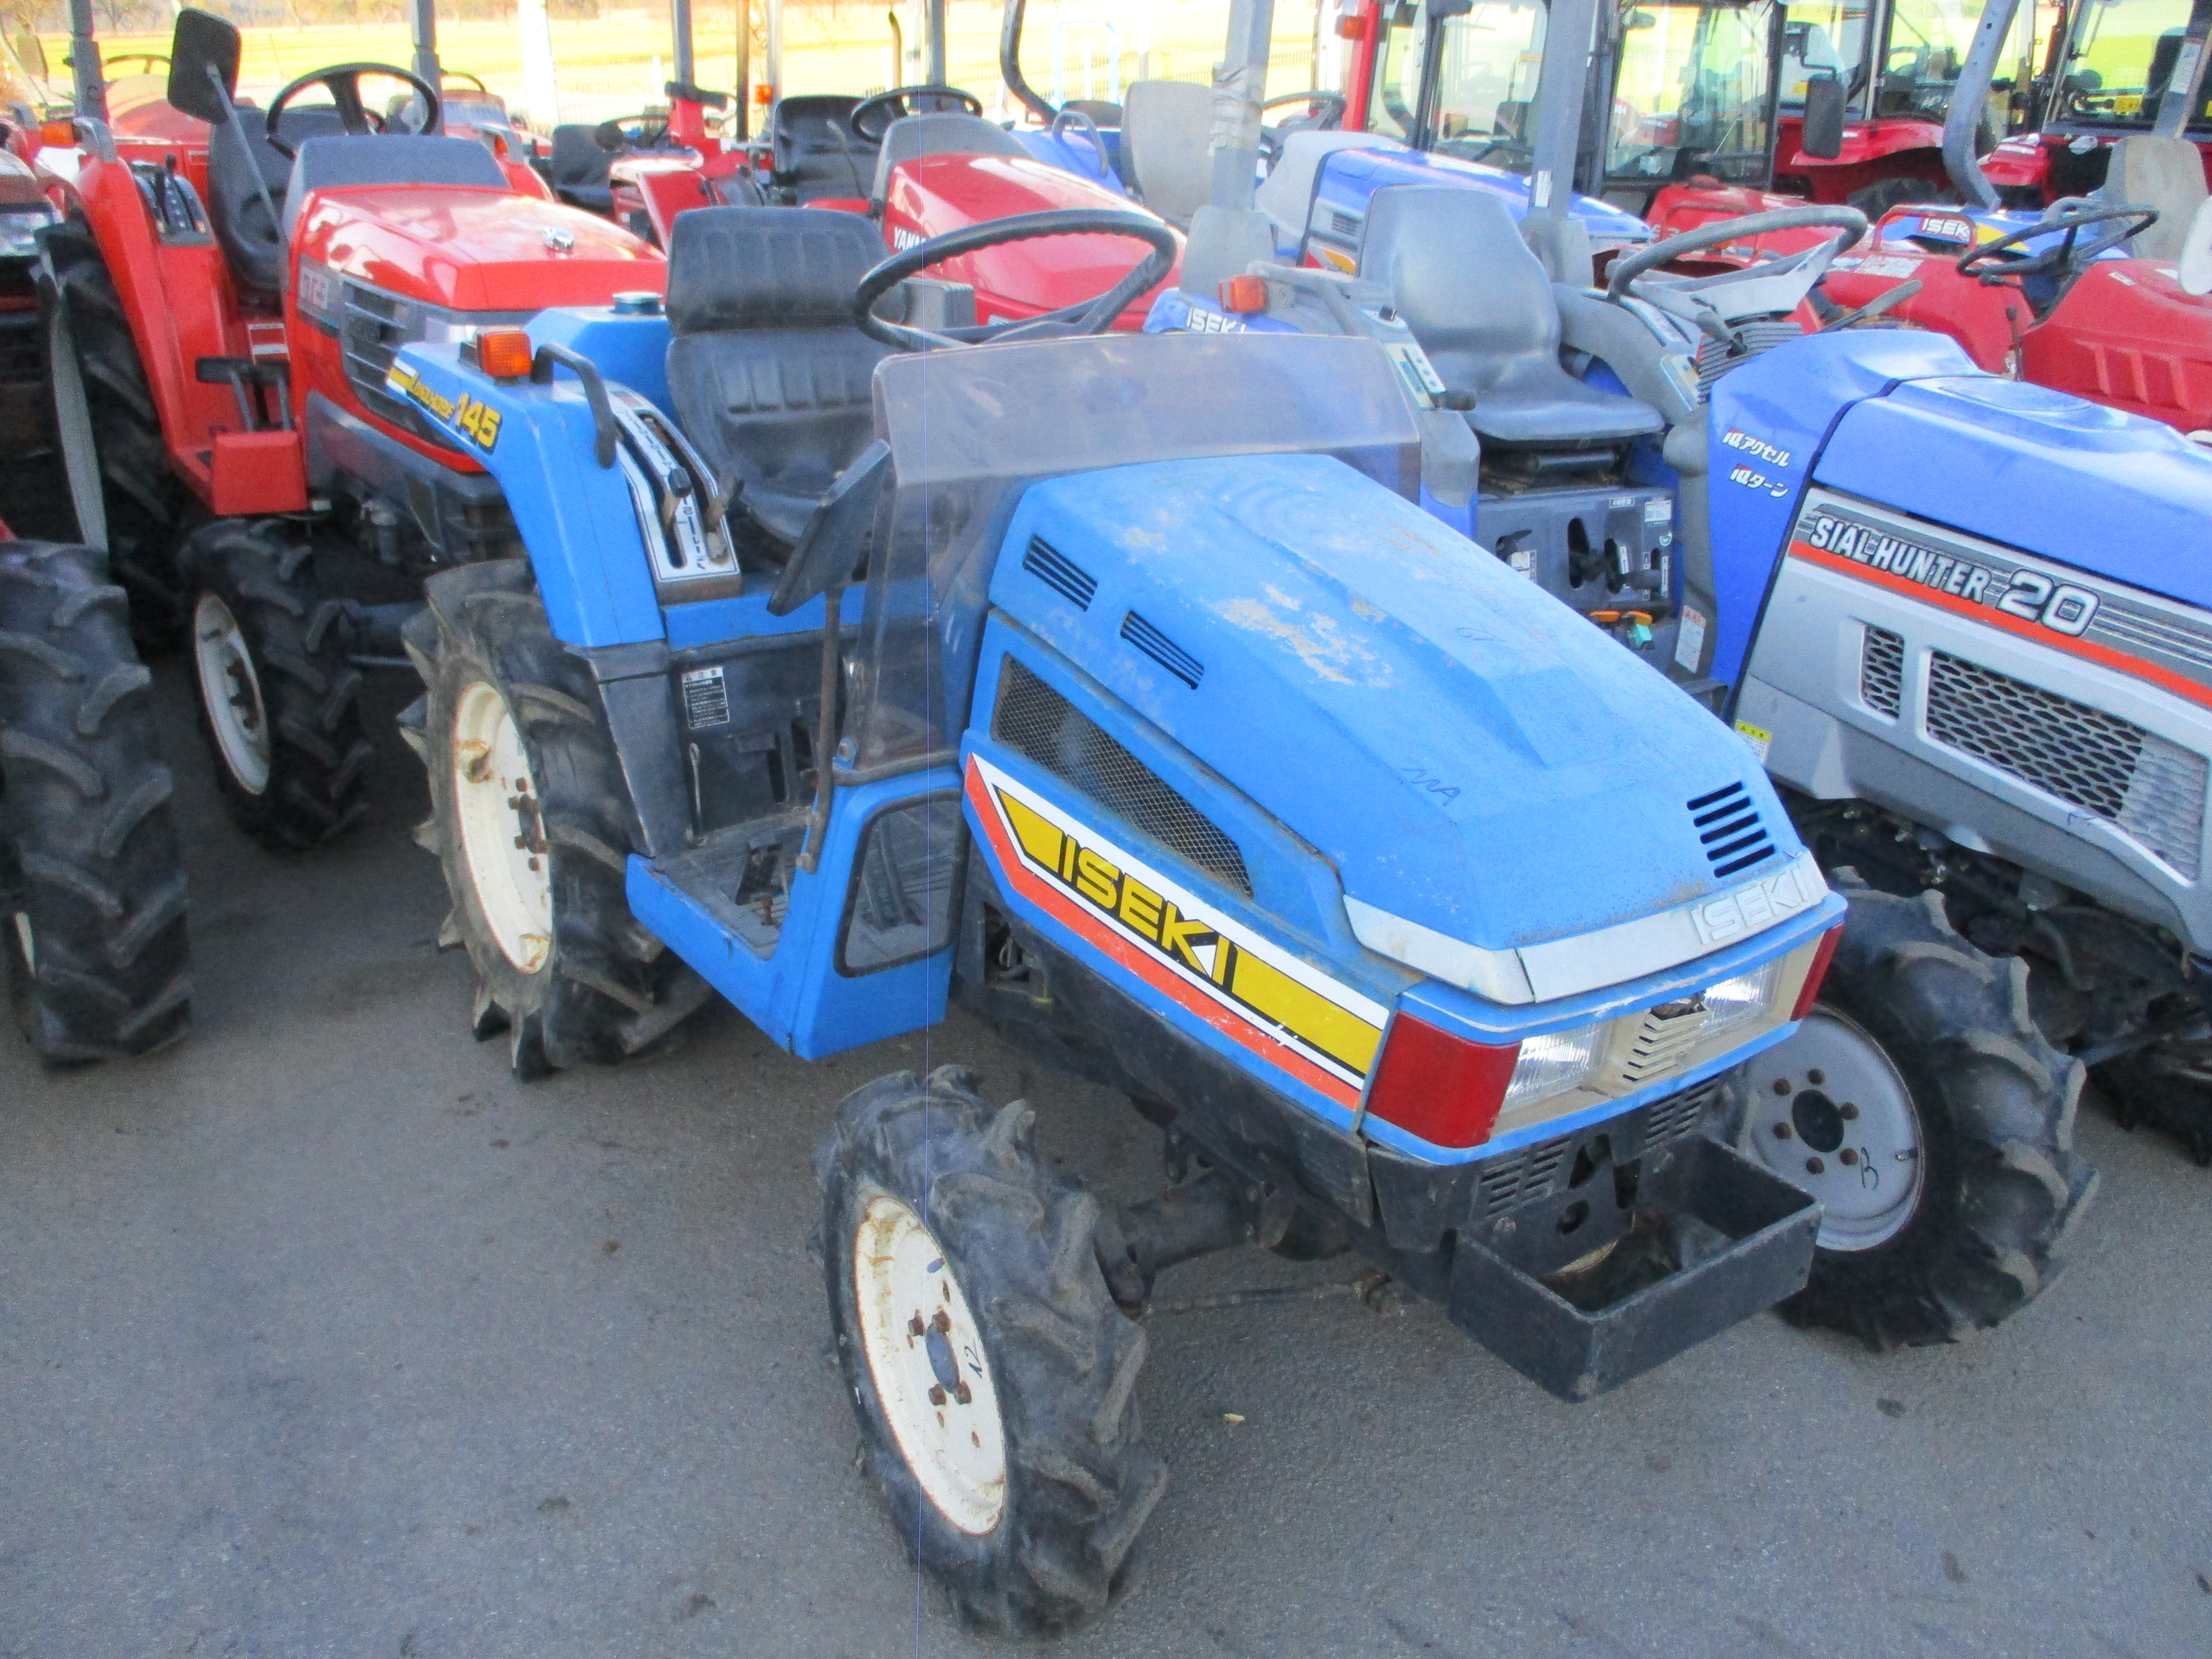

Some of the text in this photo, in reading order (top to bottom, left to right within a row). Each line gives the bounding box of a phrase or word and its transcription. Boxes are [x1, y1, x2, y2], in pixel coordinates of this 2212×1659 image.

[1917, 218, 1969, 238] ISEK
[455, 392, 502, 450] 145
[1996, 568, 2100, 636] 20
[1063, 834, 1231, 986] ISEKI
[1691, 866, 1809, 945] ISEKI
